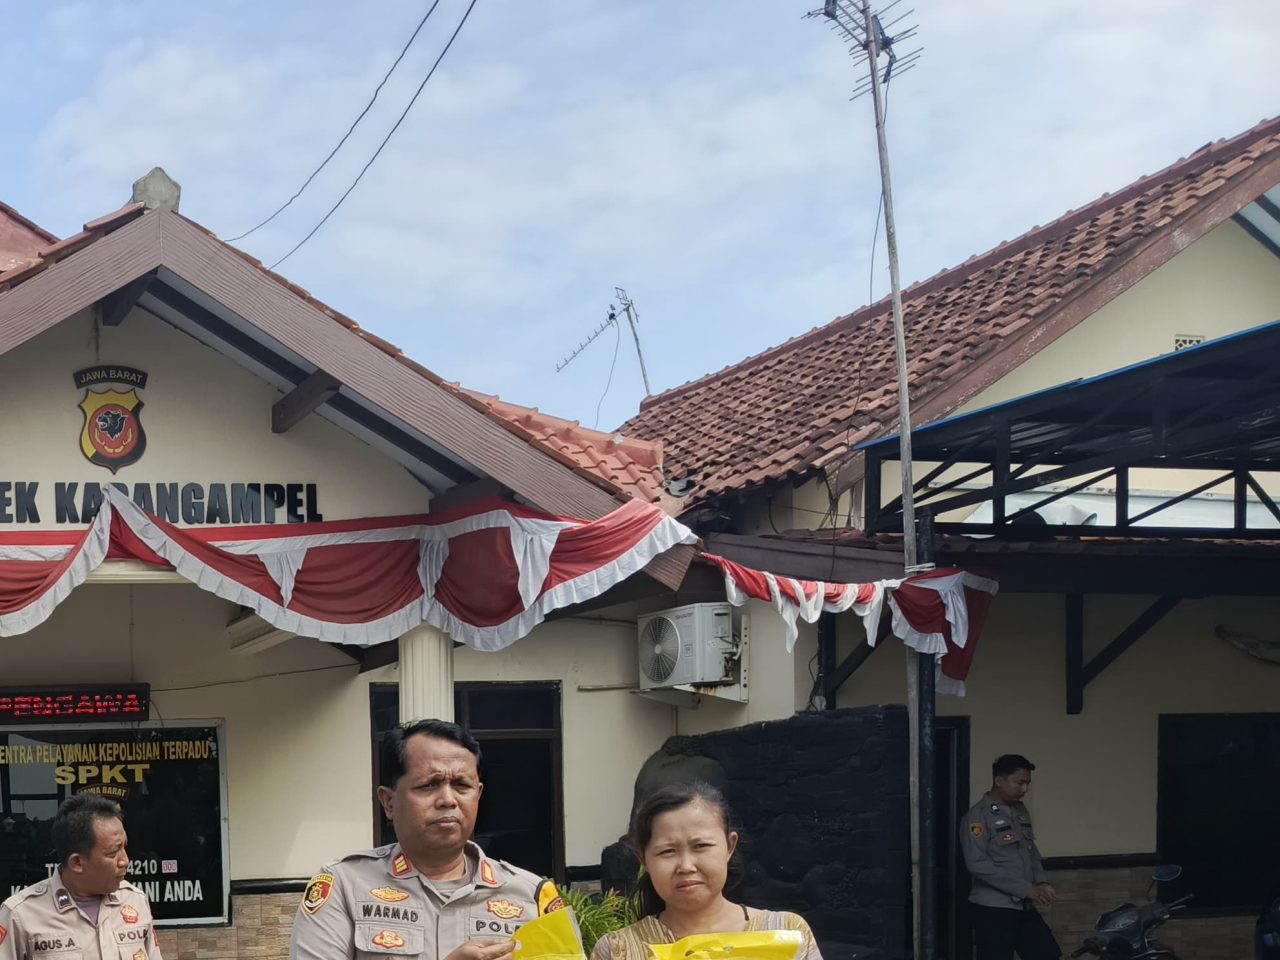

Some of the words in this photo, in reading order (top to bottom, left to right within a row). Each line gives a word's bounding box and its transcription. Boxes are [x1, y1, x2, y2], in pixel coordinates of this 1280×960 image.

[81, 370, 107, 383] JAWA
[109, 369, 143, 383] BARAT
[36, 744, 96, 763] PELAYANAN
[99, 741, 160, 762] KEPOLISIAN
[163, 740, 210, 760] TERPADU
[54, 763, 150, 785] SPKT
[164, 880, 203, 902] ANDA
[362, 904, 419, 922] WARMAD
[475, 920, 520, 935] POL
[34, 940, 63, 951] AGUS
